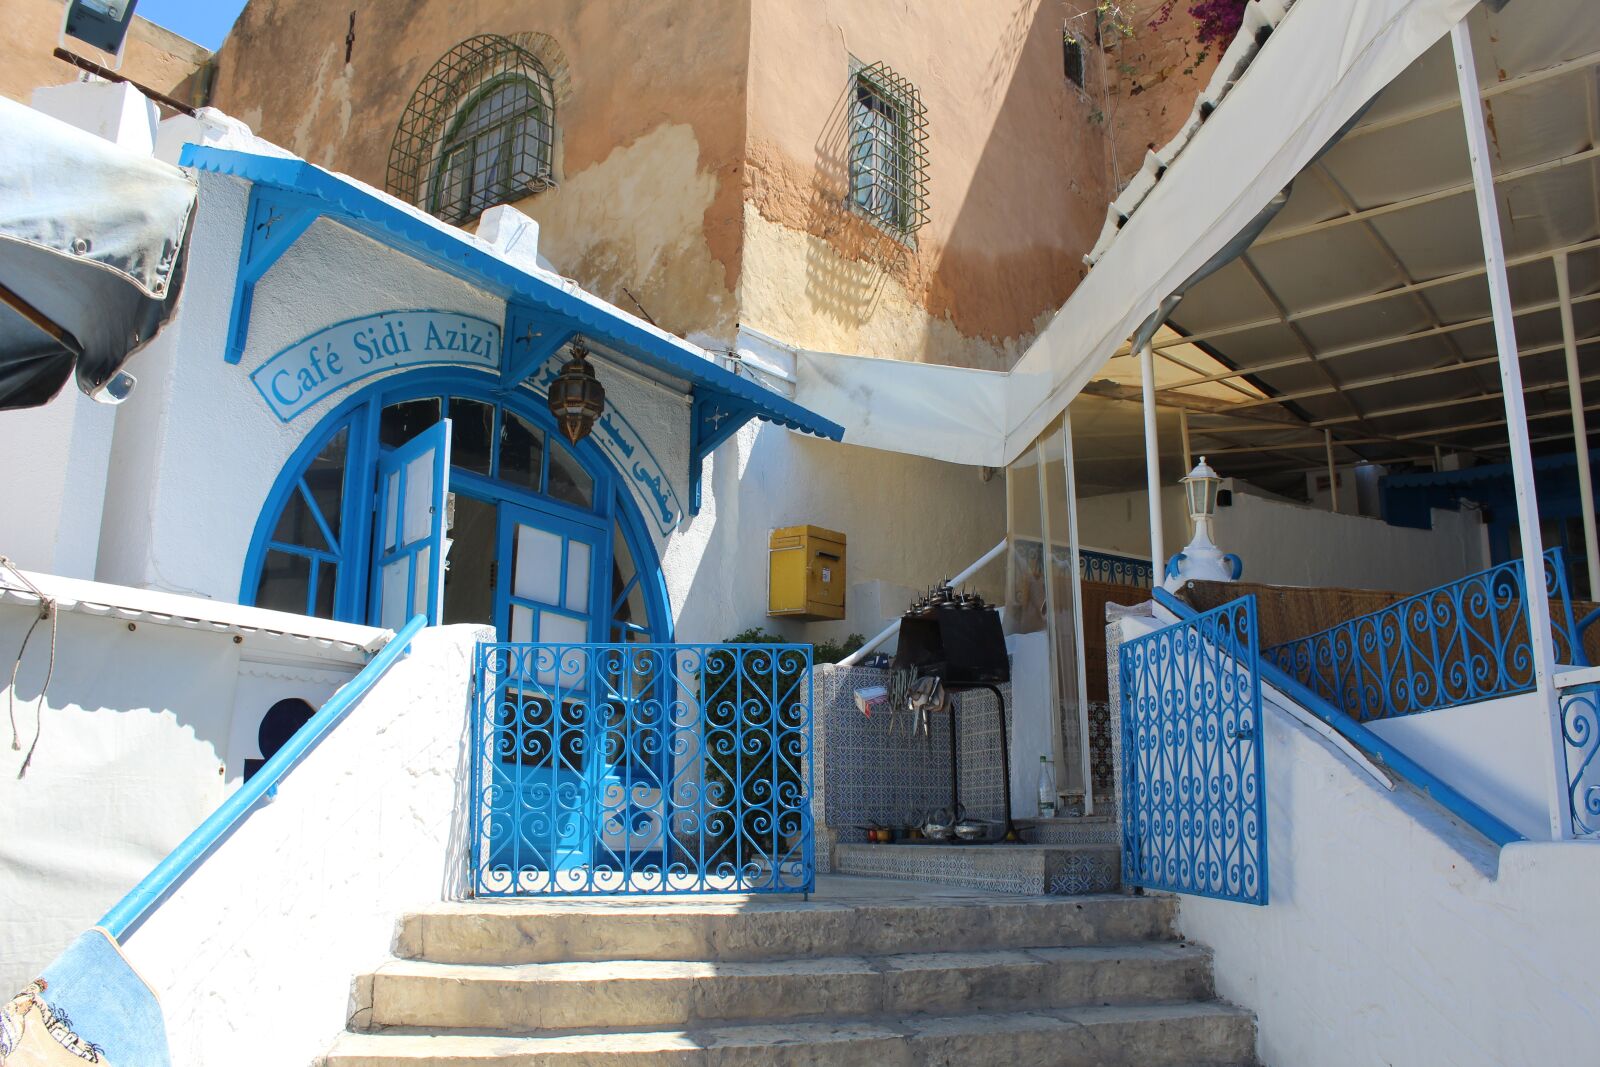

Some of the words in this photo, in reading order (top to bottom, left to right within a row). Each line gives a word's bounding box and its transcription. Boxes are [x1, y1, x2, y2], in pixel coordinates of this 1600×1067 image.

[271, 342, 343, 406] Café
[353, 321, 412, 365] Sidi
[424, 320, 494, 361] Azizi
[600, 413, 635, 459] سيد
